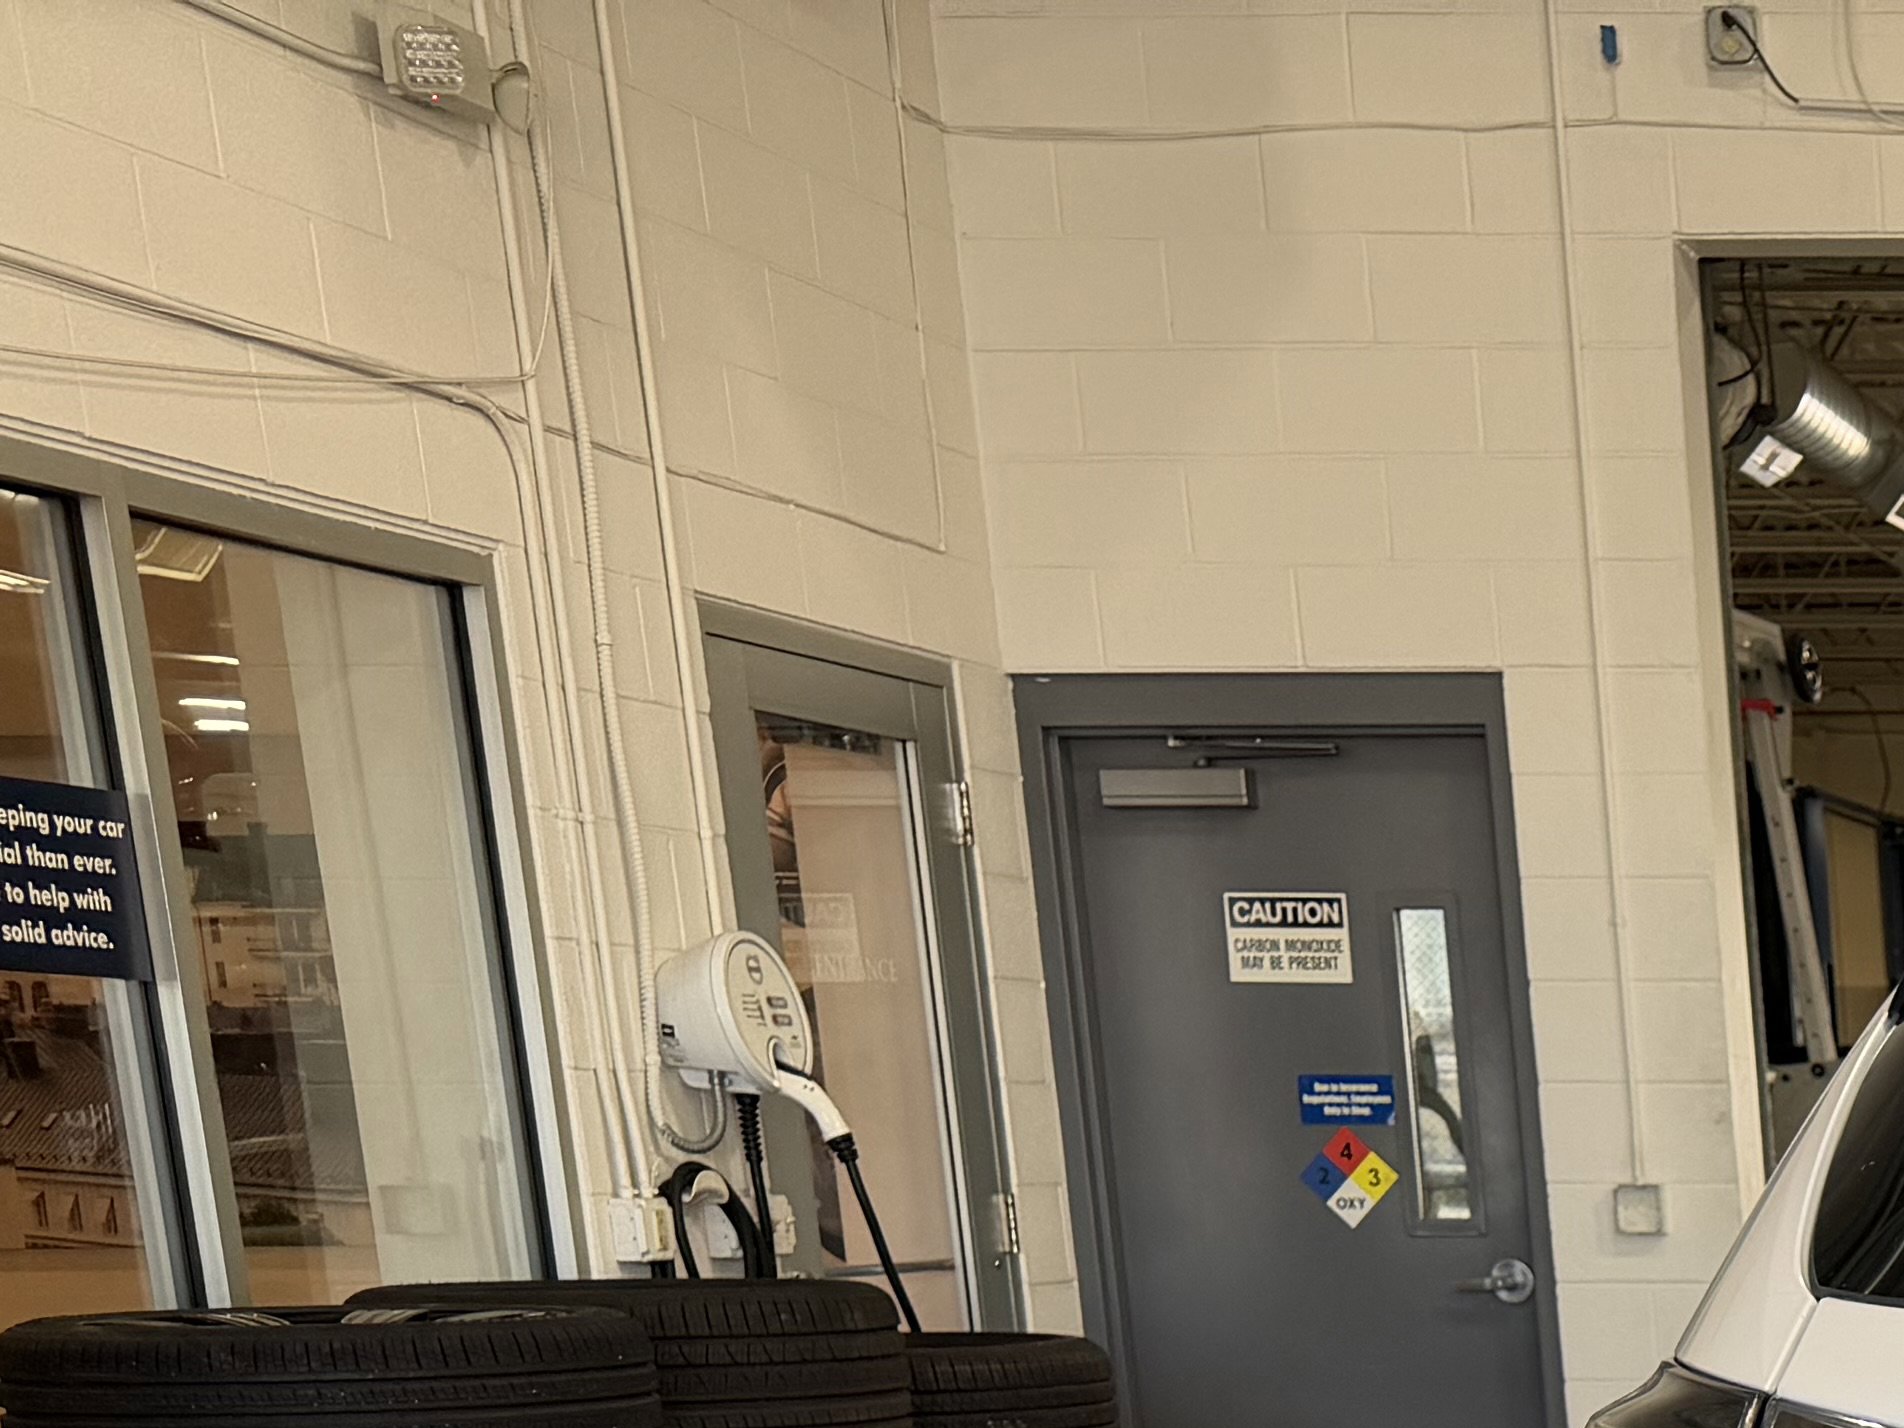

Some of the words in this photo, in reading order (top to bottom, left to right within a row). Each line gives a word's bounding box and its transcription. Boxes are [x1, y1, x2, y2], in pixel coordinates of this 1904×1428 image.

[53, 813, 94, 837] your
[98, 820, 125, 839] car
[25, 842, 69, 870] than
[73, 854, 117, 875] ever.
[4, 881, 25, 904] to
[28, 880, 70, 913] help
[73, 887, 113, 912] with
[1232, 900, 1340, 924] CAUTION
[1, 918, 47, 944] solid
[51, 922, 115, 949] advice.
[1234, 938, 1281, 953] CARBON
[1284, 938, 1344, 953] MONOXIDE
[1241, 955, 1264, 970] MAY
[1269, 955, 1284, 970] BE
[1288, 956, 1339, 970] PRESENT
[1340, 1141, 1353, 1161] 4
[1318, 1166, 1330, 1185] 2
[1367, 1167, 1382, 1187] 3
[1335, 1196, 1367, 1211] OXY
